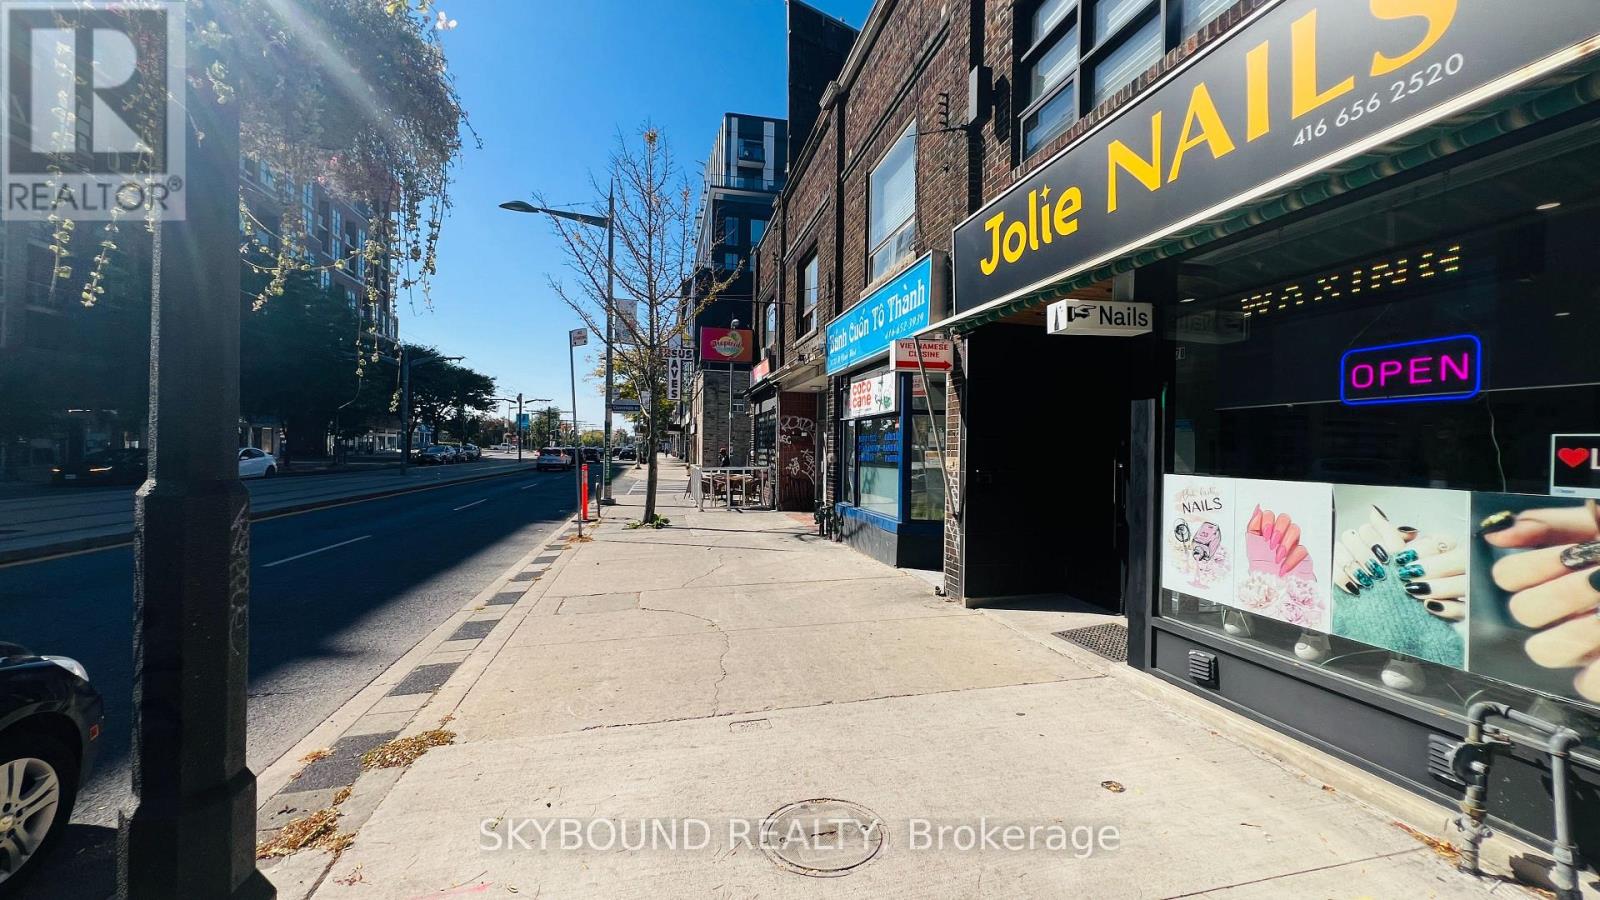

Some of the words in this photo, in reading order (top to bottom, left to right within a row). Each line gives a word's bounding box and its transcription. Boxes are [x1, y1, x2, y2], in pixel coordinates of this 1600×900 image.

[1292, 122, 1328, 148] 416
[1335, 96, 1381, 128] 656
[1390, 52, 1465, 102] 2520
[980, 184, 1082, 276] Jolie
[1106, 0, 1459, 213] NAILS
[872, 303, 885, 331] Tô
[887, 279, 925, 322] Thành
[1099, 304, 1149, 328] Nails
[900, 342, 949, 351] VIETAMESE
[1351, 352, 1470, 389] OPEN
[852, 380, 872, 396] coco
[852, 393, 872, 408] cane
[1182, 497, 1223, 514] NAILS
